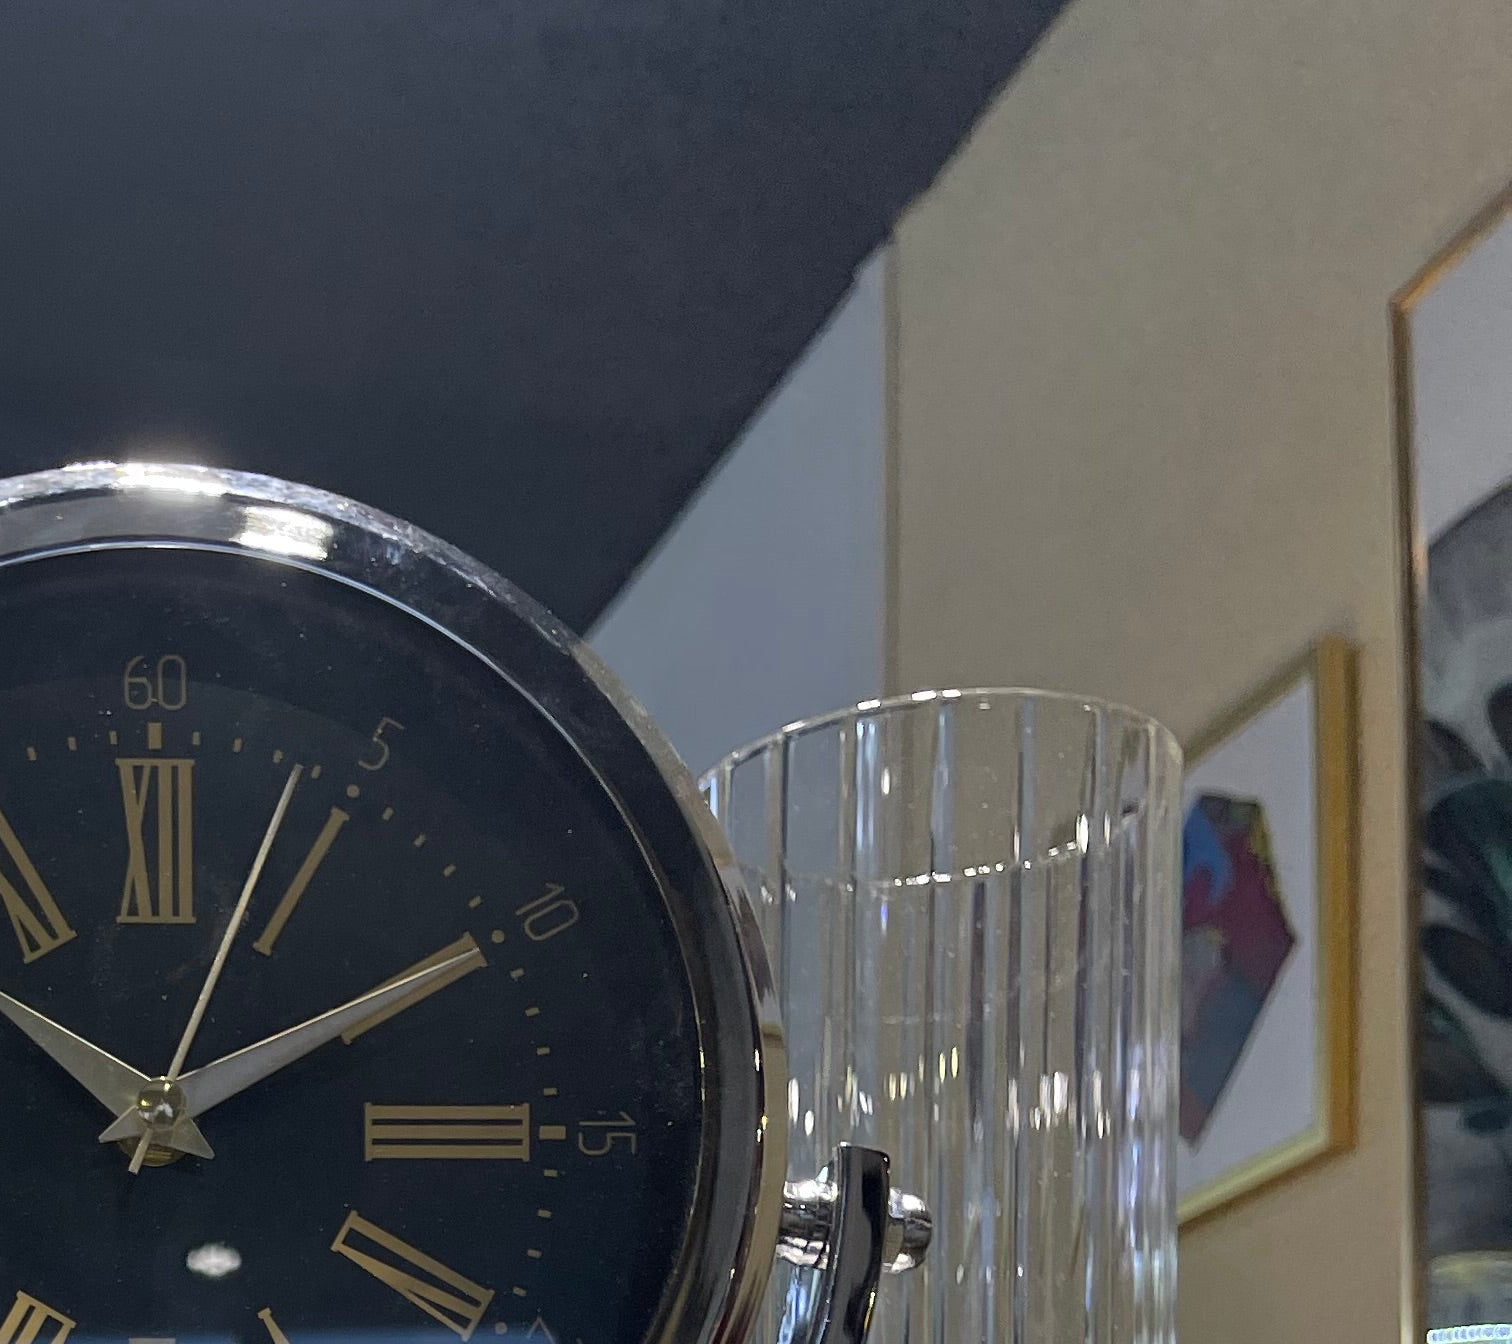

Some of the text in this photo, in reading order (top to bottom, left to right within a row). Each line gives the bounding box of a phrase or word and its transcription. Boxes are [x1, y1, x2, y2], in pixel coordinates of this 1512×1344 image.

[123, 655, 186, 710] 60
[358, 717, 405, 771] 5
[115, 758, 196, 923] XII
[515, 882, 579, 941] 10
[364, 1102, 530, 1162] III
[578, 1111, 637, 1155] 15
[330, 1210, 495, 1342] IV
